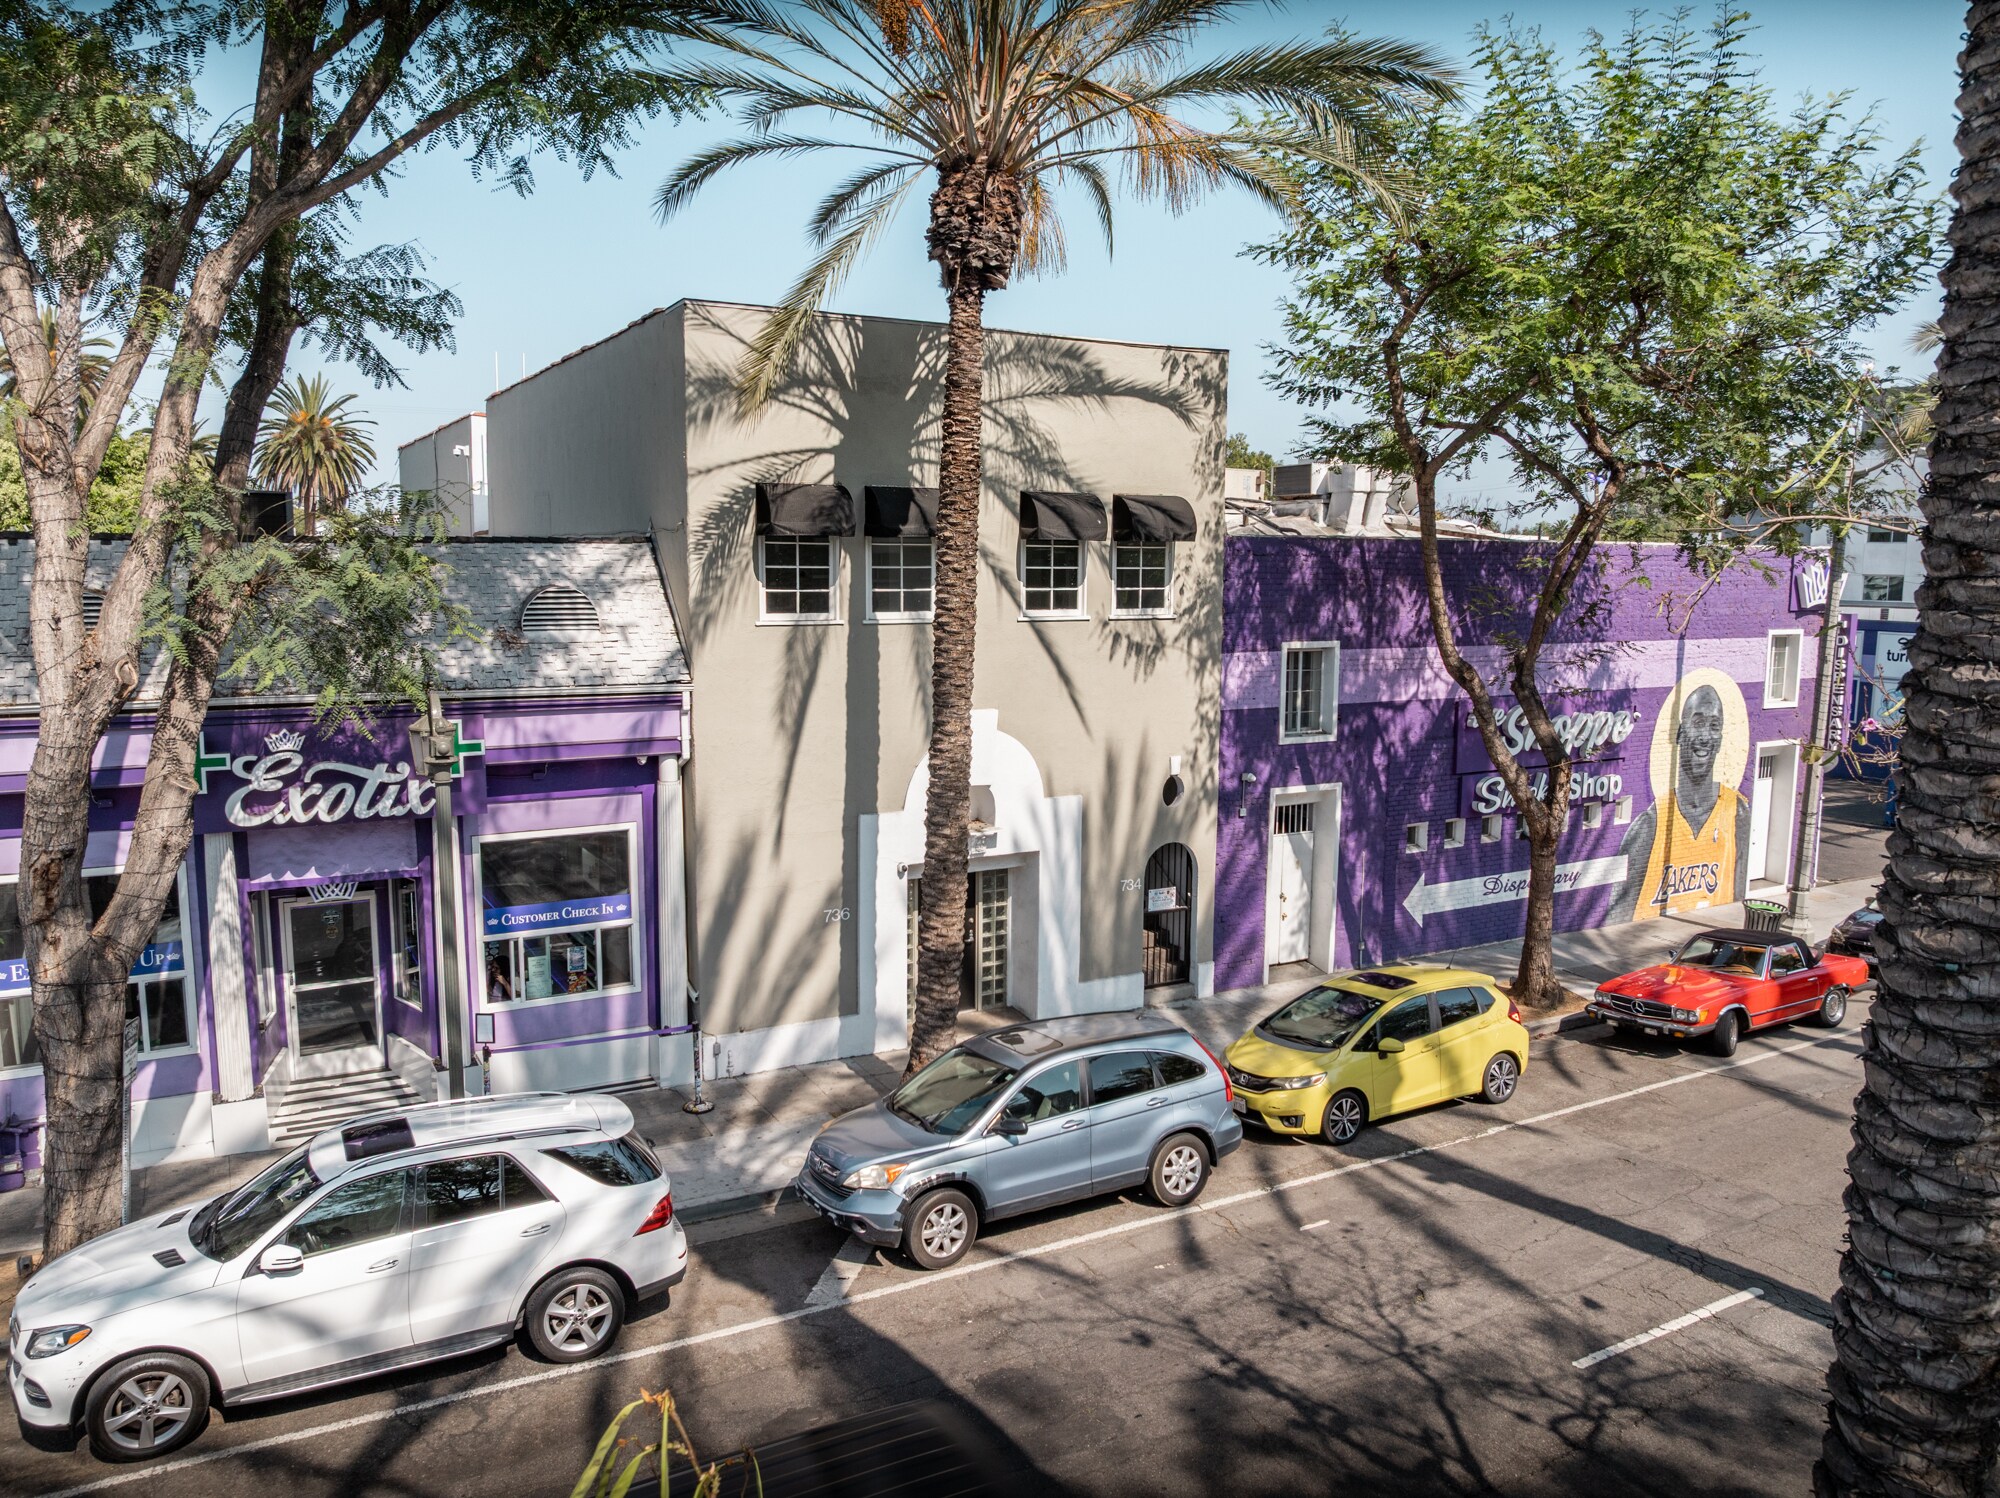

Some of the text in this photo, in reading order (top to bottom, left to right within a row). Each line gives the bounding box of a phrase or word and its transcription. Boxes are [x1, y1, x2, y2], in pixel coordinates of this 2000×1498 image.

[1887, 649, 1908, 662] tur
[1828, 635, 1848, 750] DISPENSARY
[225, 752, 436, 827] Exotix
[1570, 772, 1623, 802] Shop
[1120, 878, 1142, 892] 734
[1483, 874, 1581, 897] Dispary
[1650, 862, 1719, 906] LAKERS
[823, 907, 851, 923] 736
